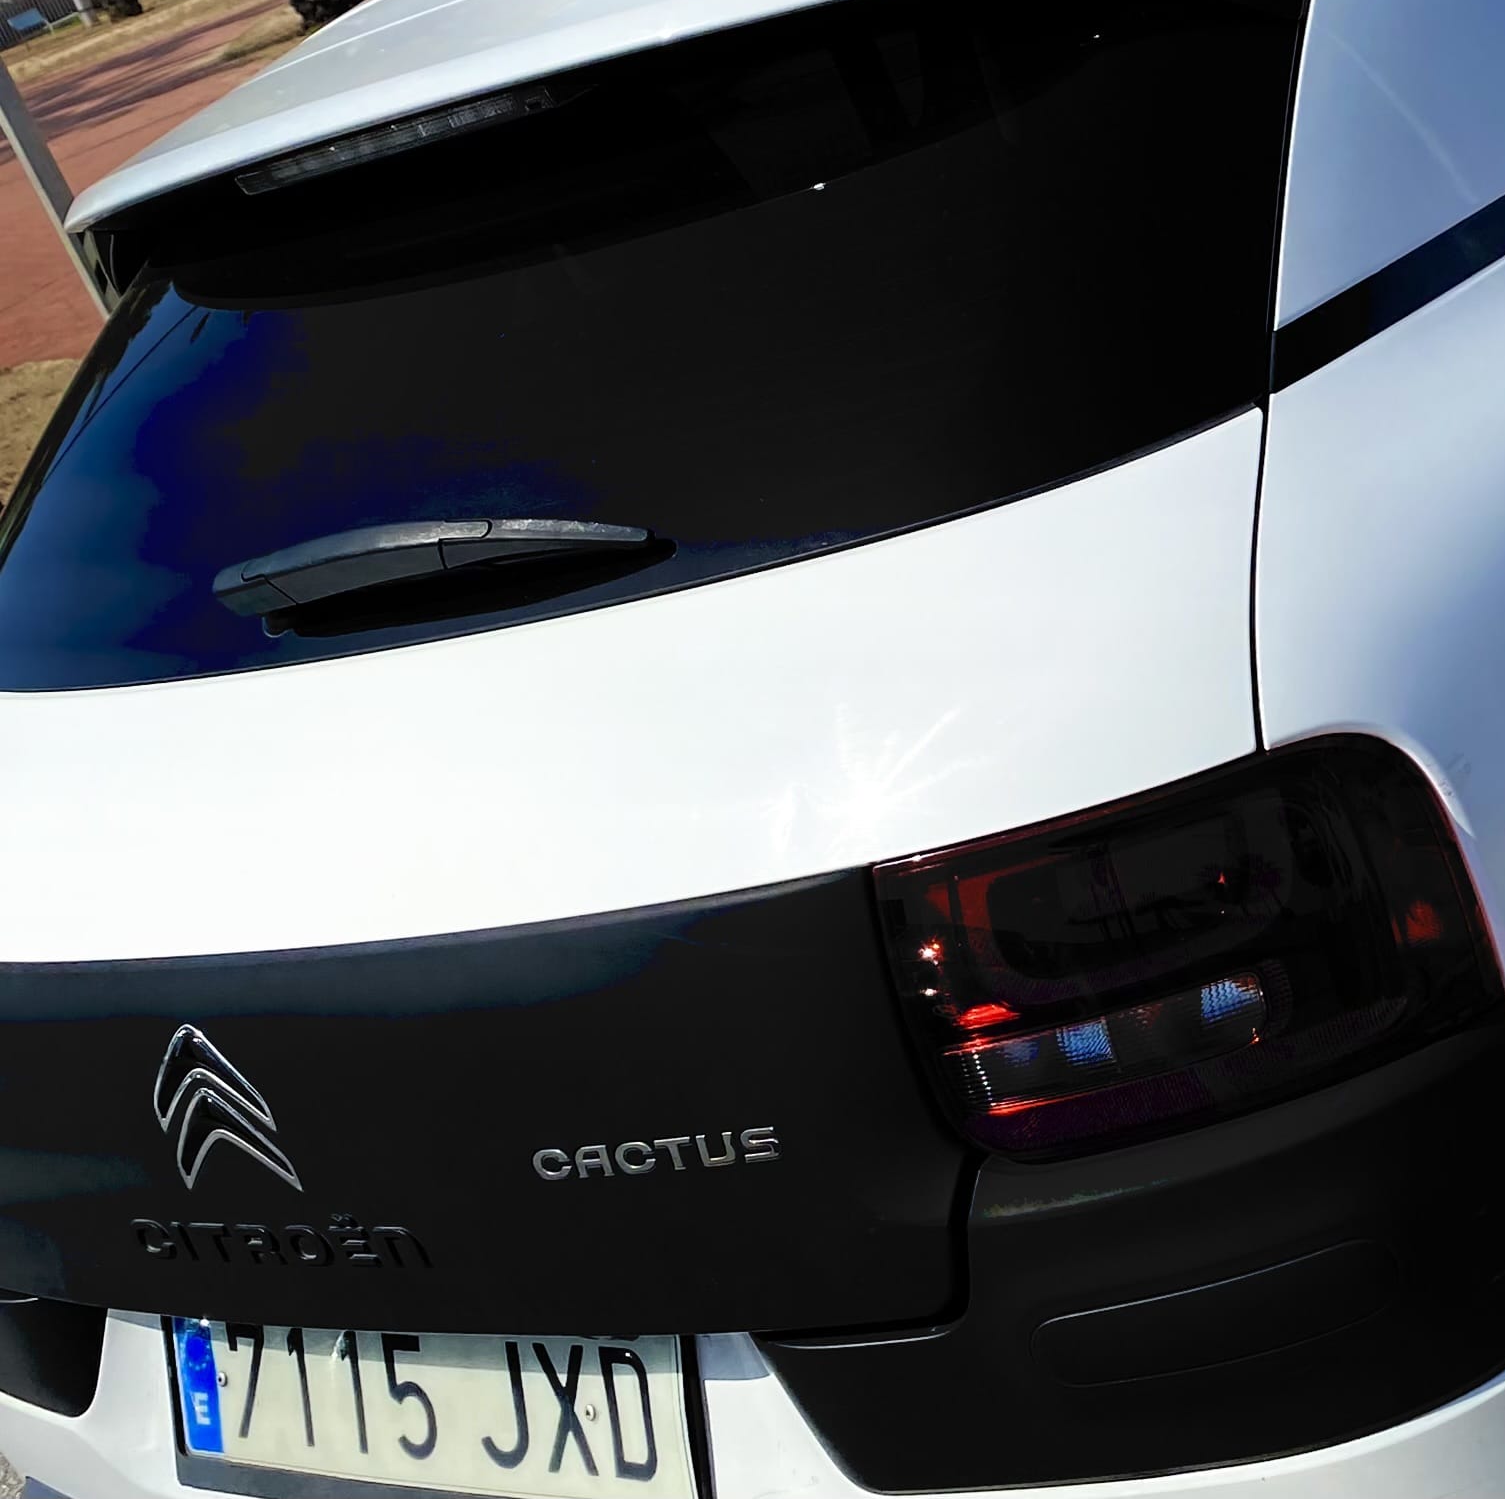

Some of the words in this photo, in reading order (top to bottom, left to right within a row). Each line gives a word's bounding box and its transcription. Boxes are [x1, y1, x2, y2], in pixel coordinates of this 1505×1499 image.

[531, 1125, 783, 1181] CACTUS
[194, 1392, 211, 1426] E
[224, 1321, 438, 1461] 7115
[481, 1341, 658, 1482] JXD
